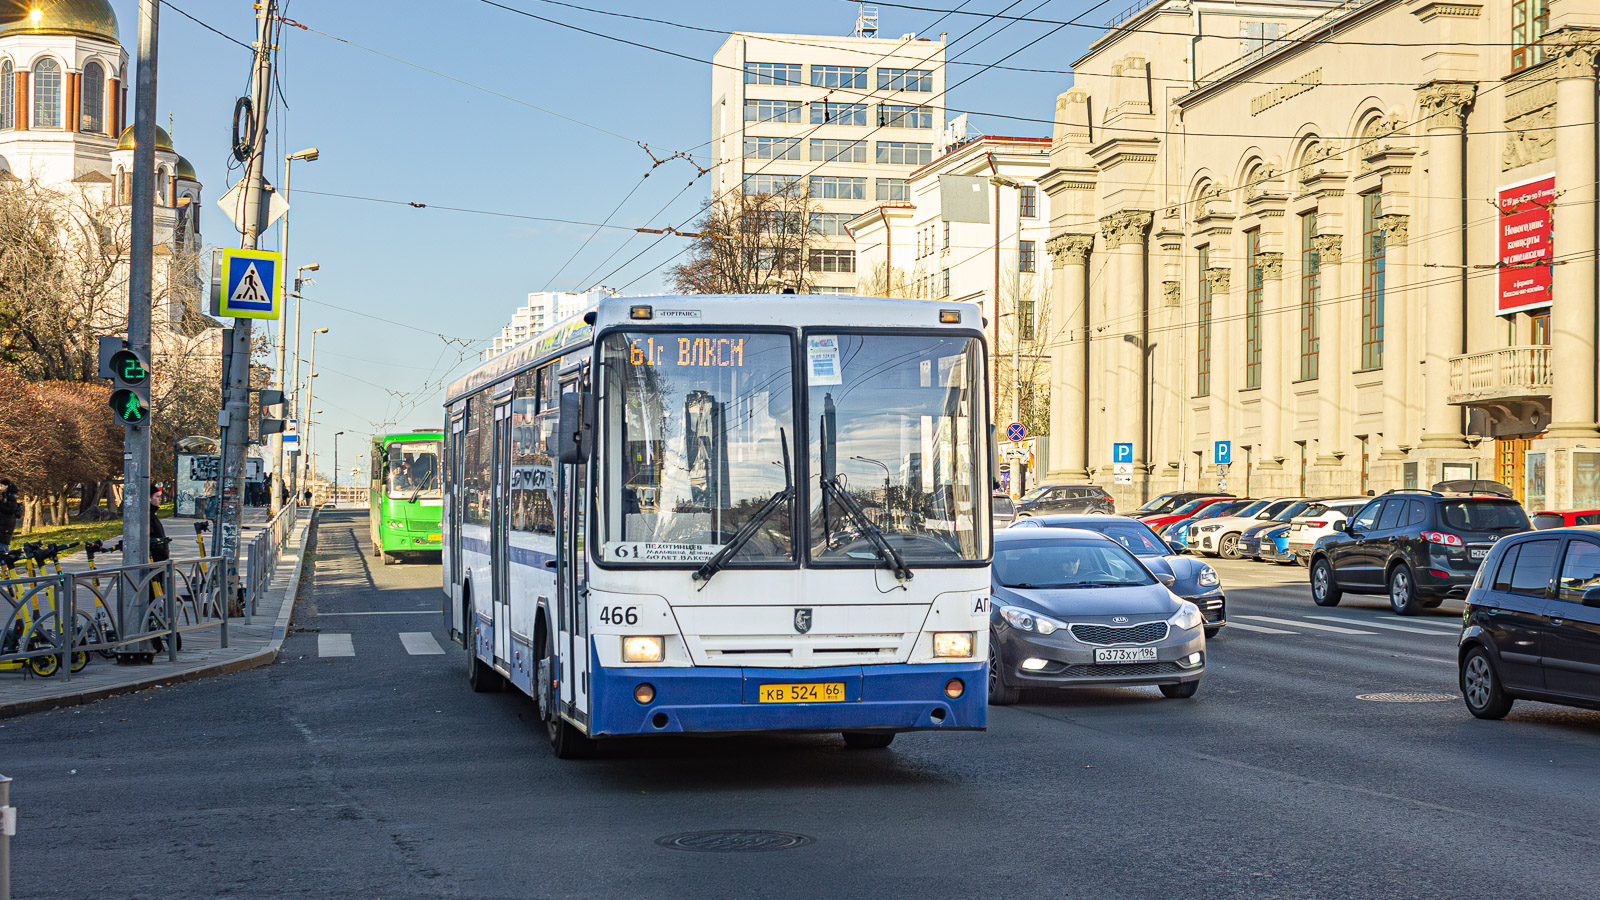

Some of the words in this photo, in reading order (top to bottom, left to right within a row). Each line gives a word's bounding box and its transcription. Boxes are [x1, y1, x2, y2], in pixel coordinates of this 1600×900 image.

[1504, 219, 1544, 237] Новогодние
[1507, 234, 1540, 250] концерты
[677, 337, 744, 367] ВЛКСМ
[125, 360, 145, 378] 23
[1118, 445, 1130, 461] P
[1218, 443, 1228, 461] P
[614, 544, 640, 559] 61
[645, 543, 703, 551] ПЕХОТИНЦЕВ
[599, 606, 638, 625] 466
[1140, 648, 1154, 657] 196
[767, 689, 784, 700] КВ
[791, 685, 818, 699] 524
[826, 684, 840, 695] 66
